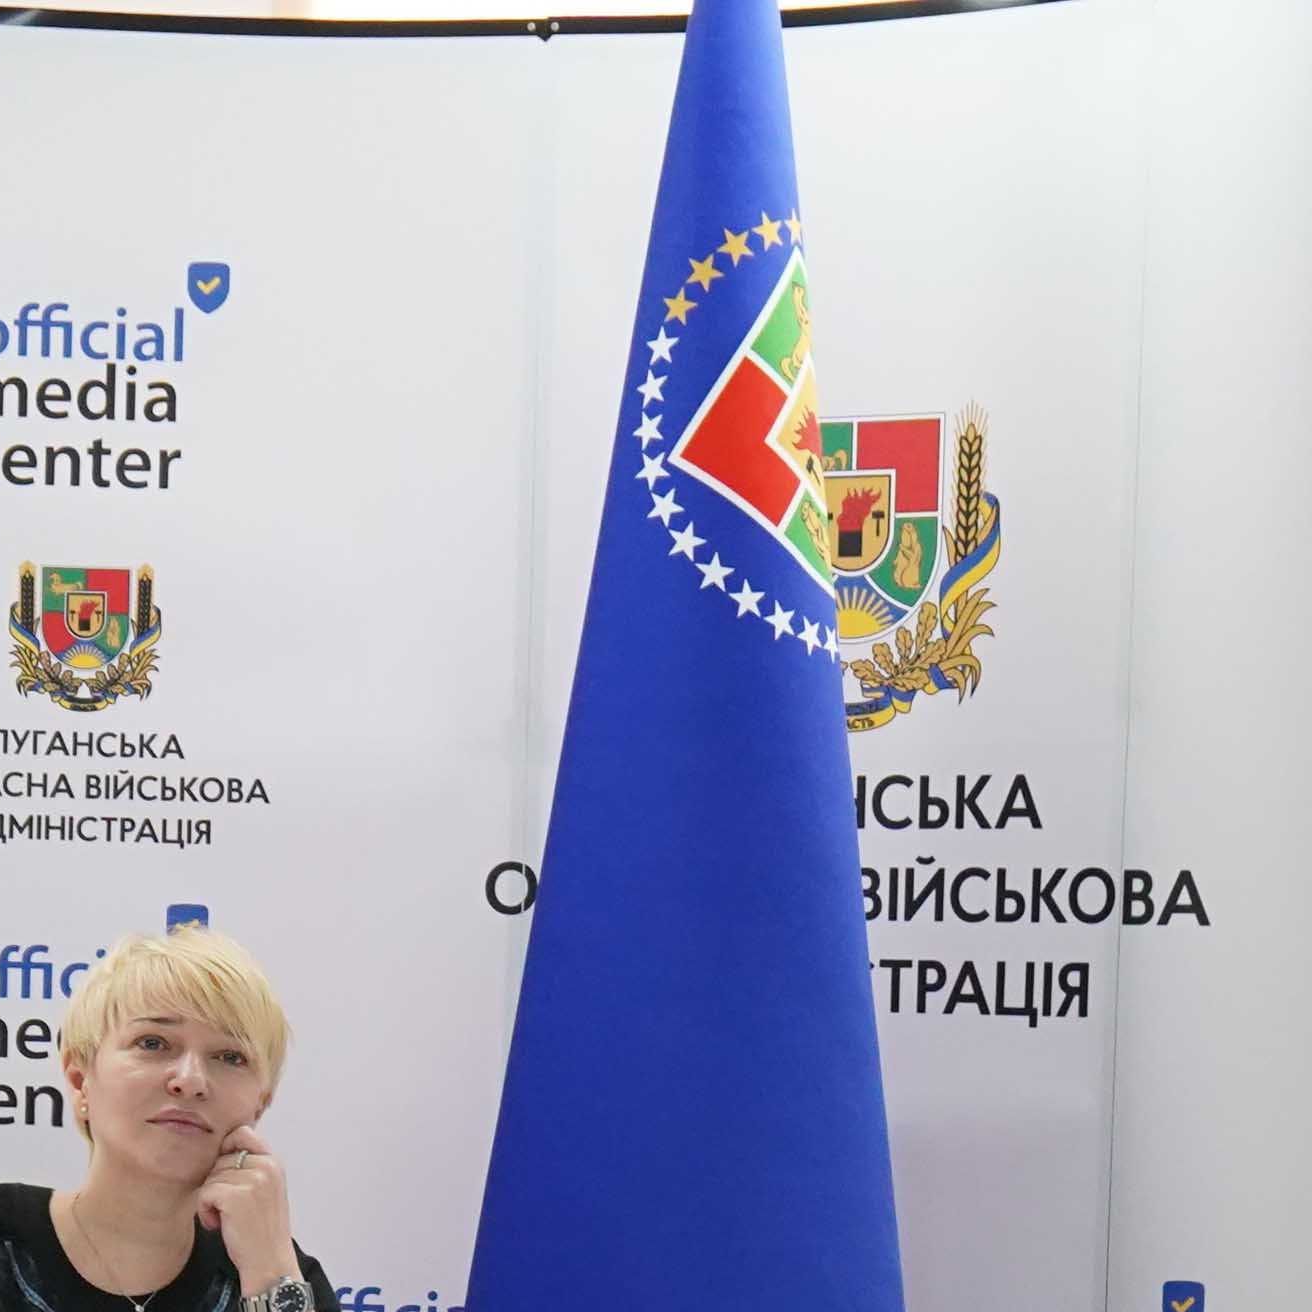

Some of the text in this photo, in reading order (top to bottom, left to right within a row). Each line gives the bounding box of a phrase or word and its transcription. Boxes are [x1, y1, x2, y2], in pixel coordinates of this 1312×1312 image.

[85, 769, 270, 804] ВІЙСЬКОВА
[855, 774, 1042, 829] СЬКА
[870, 959, 1089, 1028] ТРАЦІЯ
